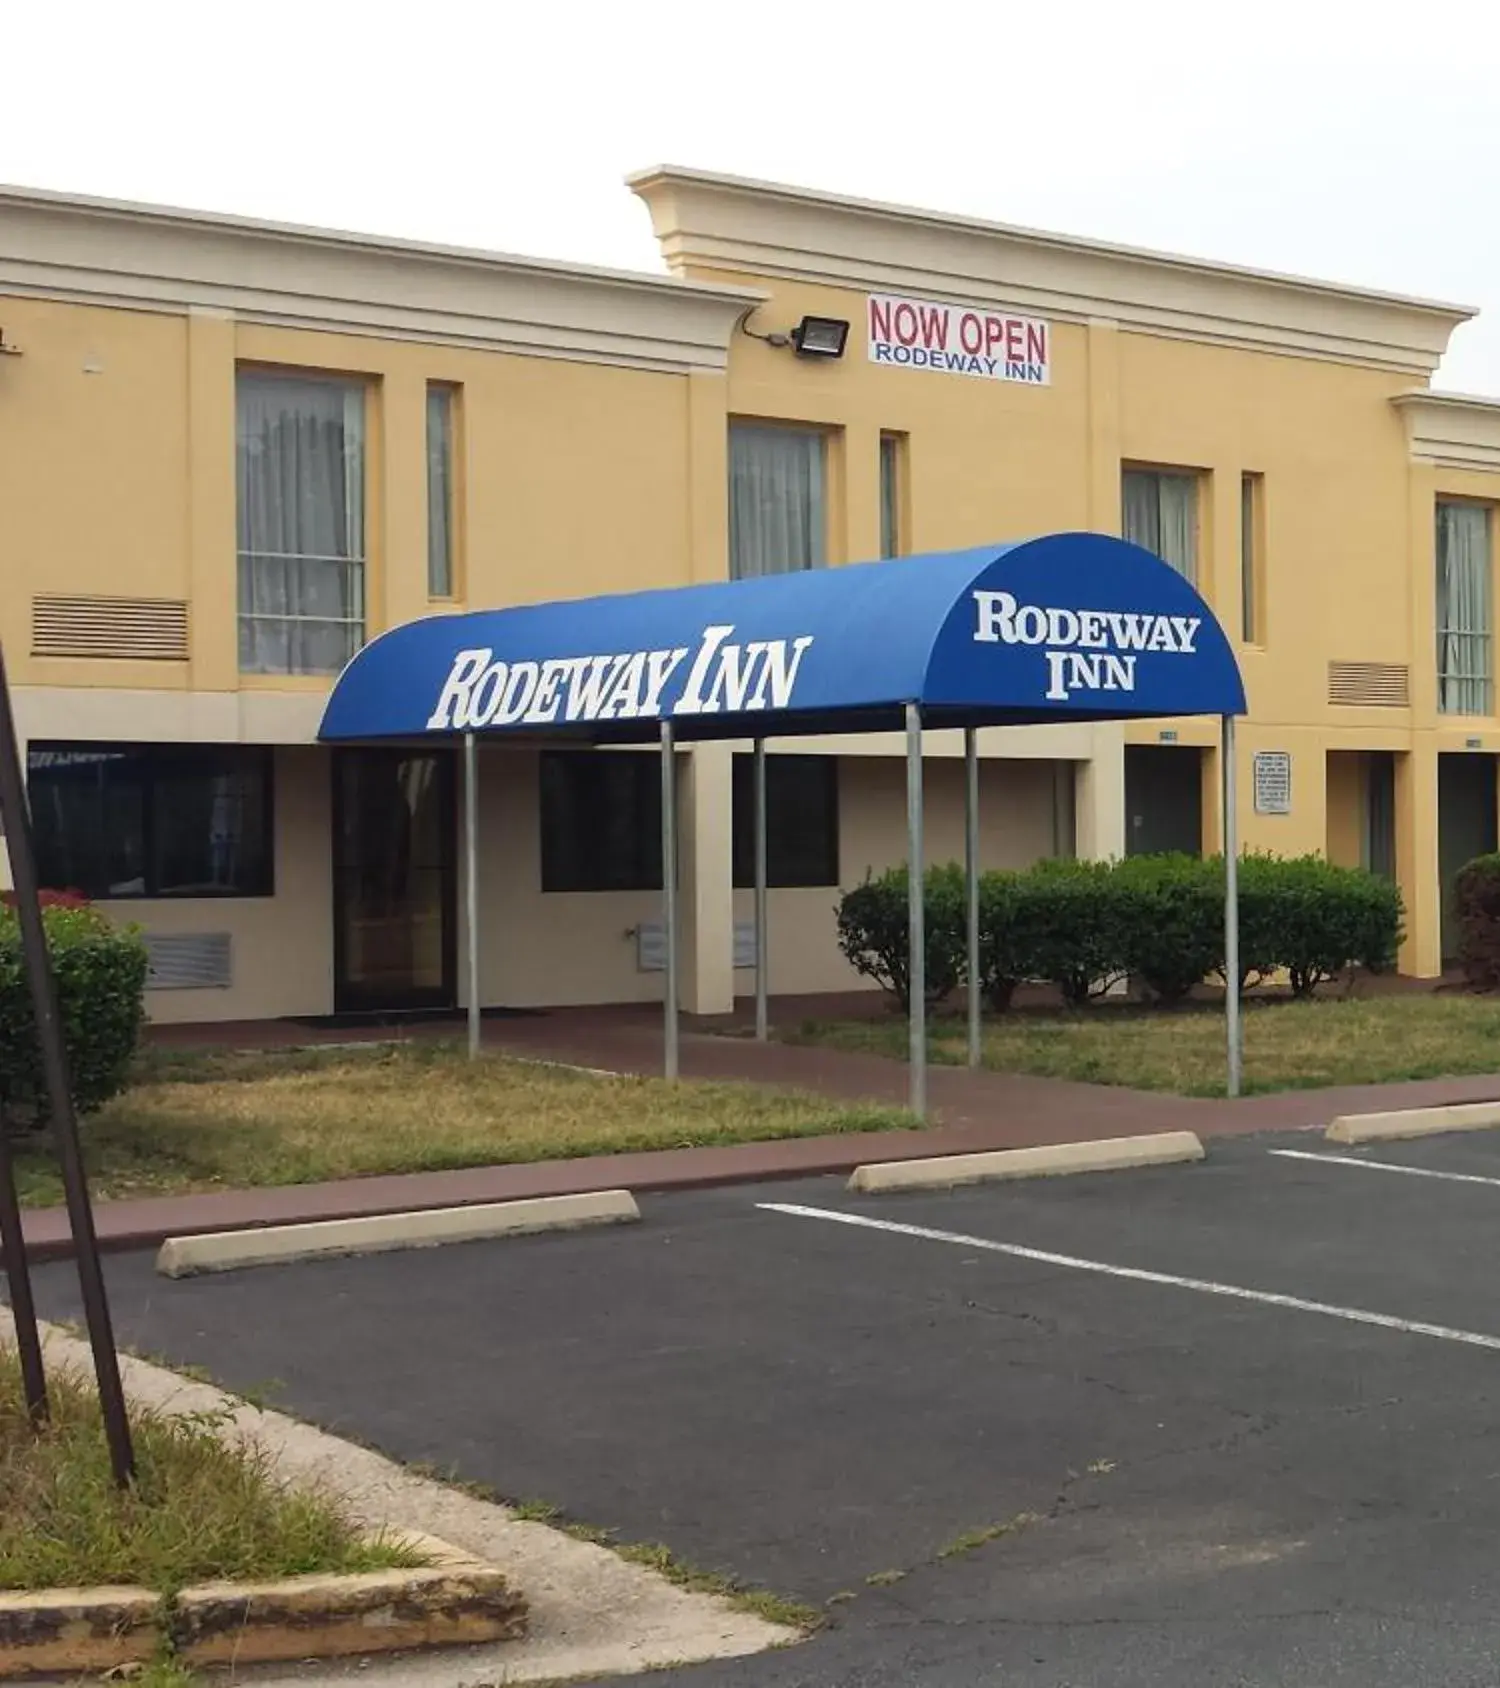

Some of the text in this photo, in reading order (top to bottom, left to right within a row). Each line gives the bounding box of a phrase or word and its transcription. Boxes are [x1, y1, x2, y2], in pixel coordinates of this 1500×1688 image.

[870, 299, 1046, 364] NOW OPEN
[875, 343, 1042, 382] RODEWAY INN
[973, 589, 1200, 652] RODEWAY
[426, 624, 814, 729] RODEWAY INN
[1045, 651, 1136, 700] INN
